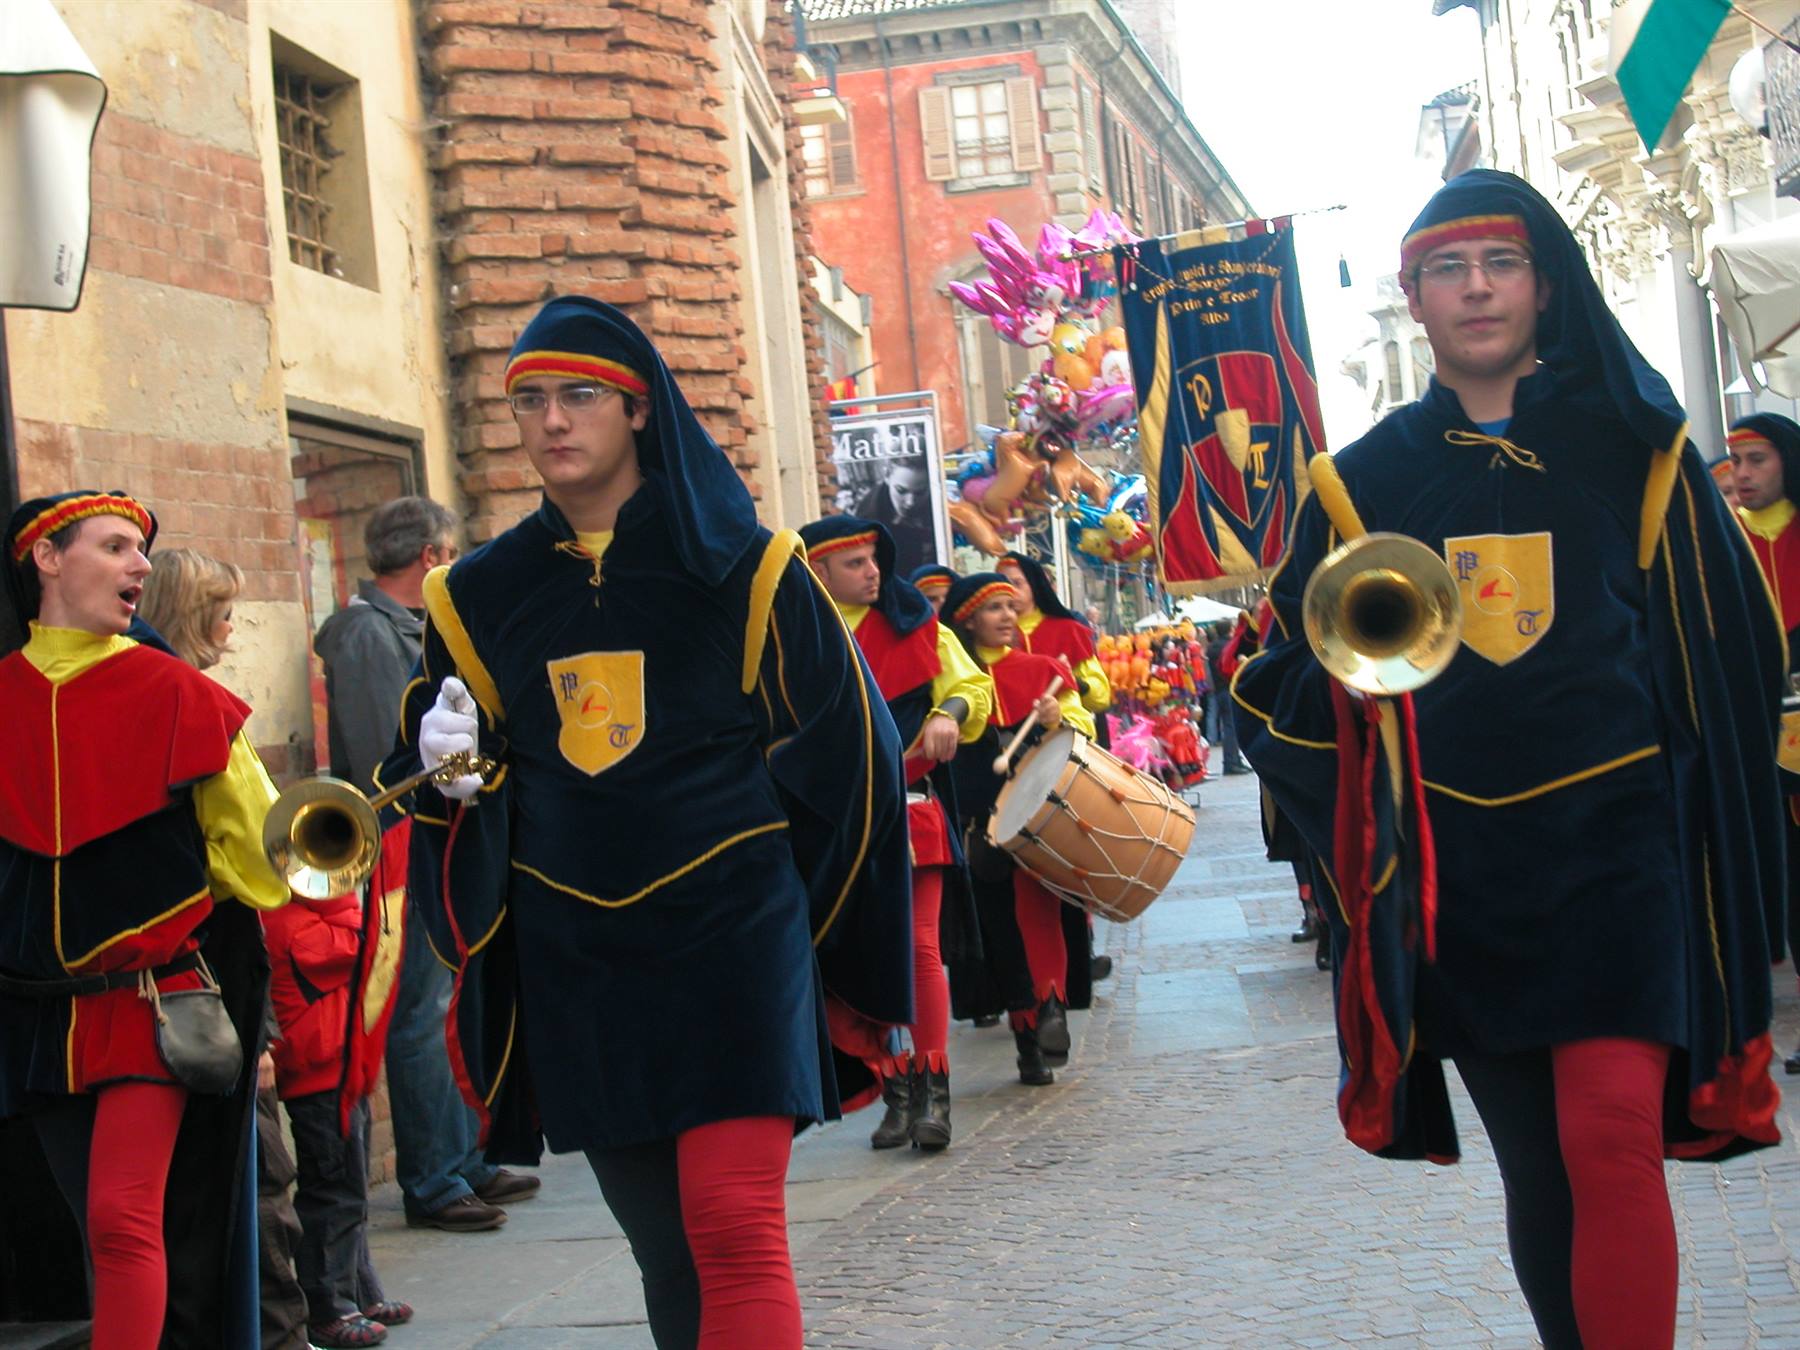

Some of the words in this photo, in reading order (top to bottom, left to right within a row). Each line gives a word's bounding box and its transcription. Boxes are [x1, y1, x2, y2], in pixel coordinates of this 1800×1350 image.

[830, 425, 922, 462] Match
[1456, 550, 1479, 581] P
[559, 672, 578, 702] P
